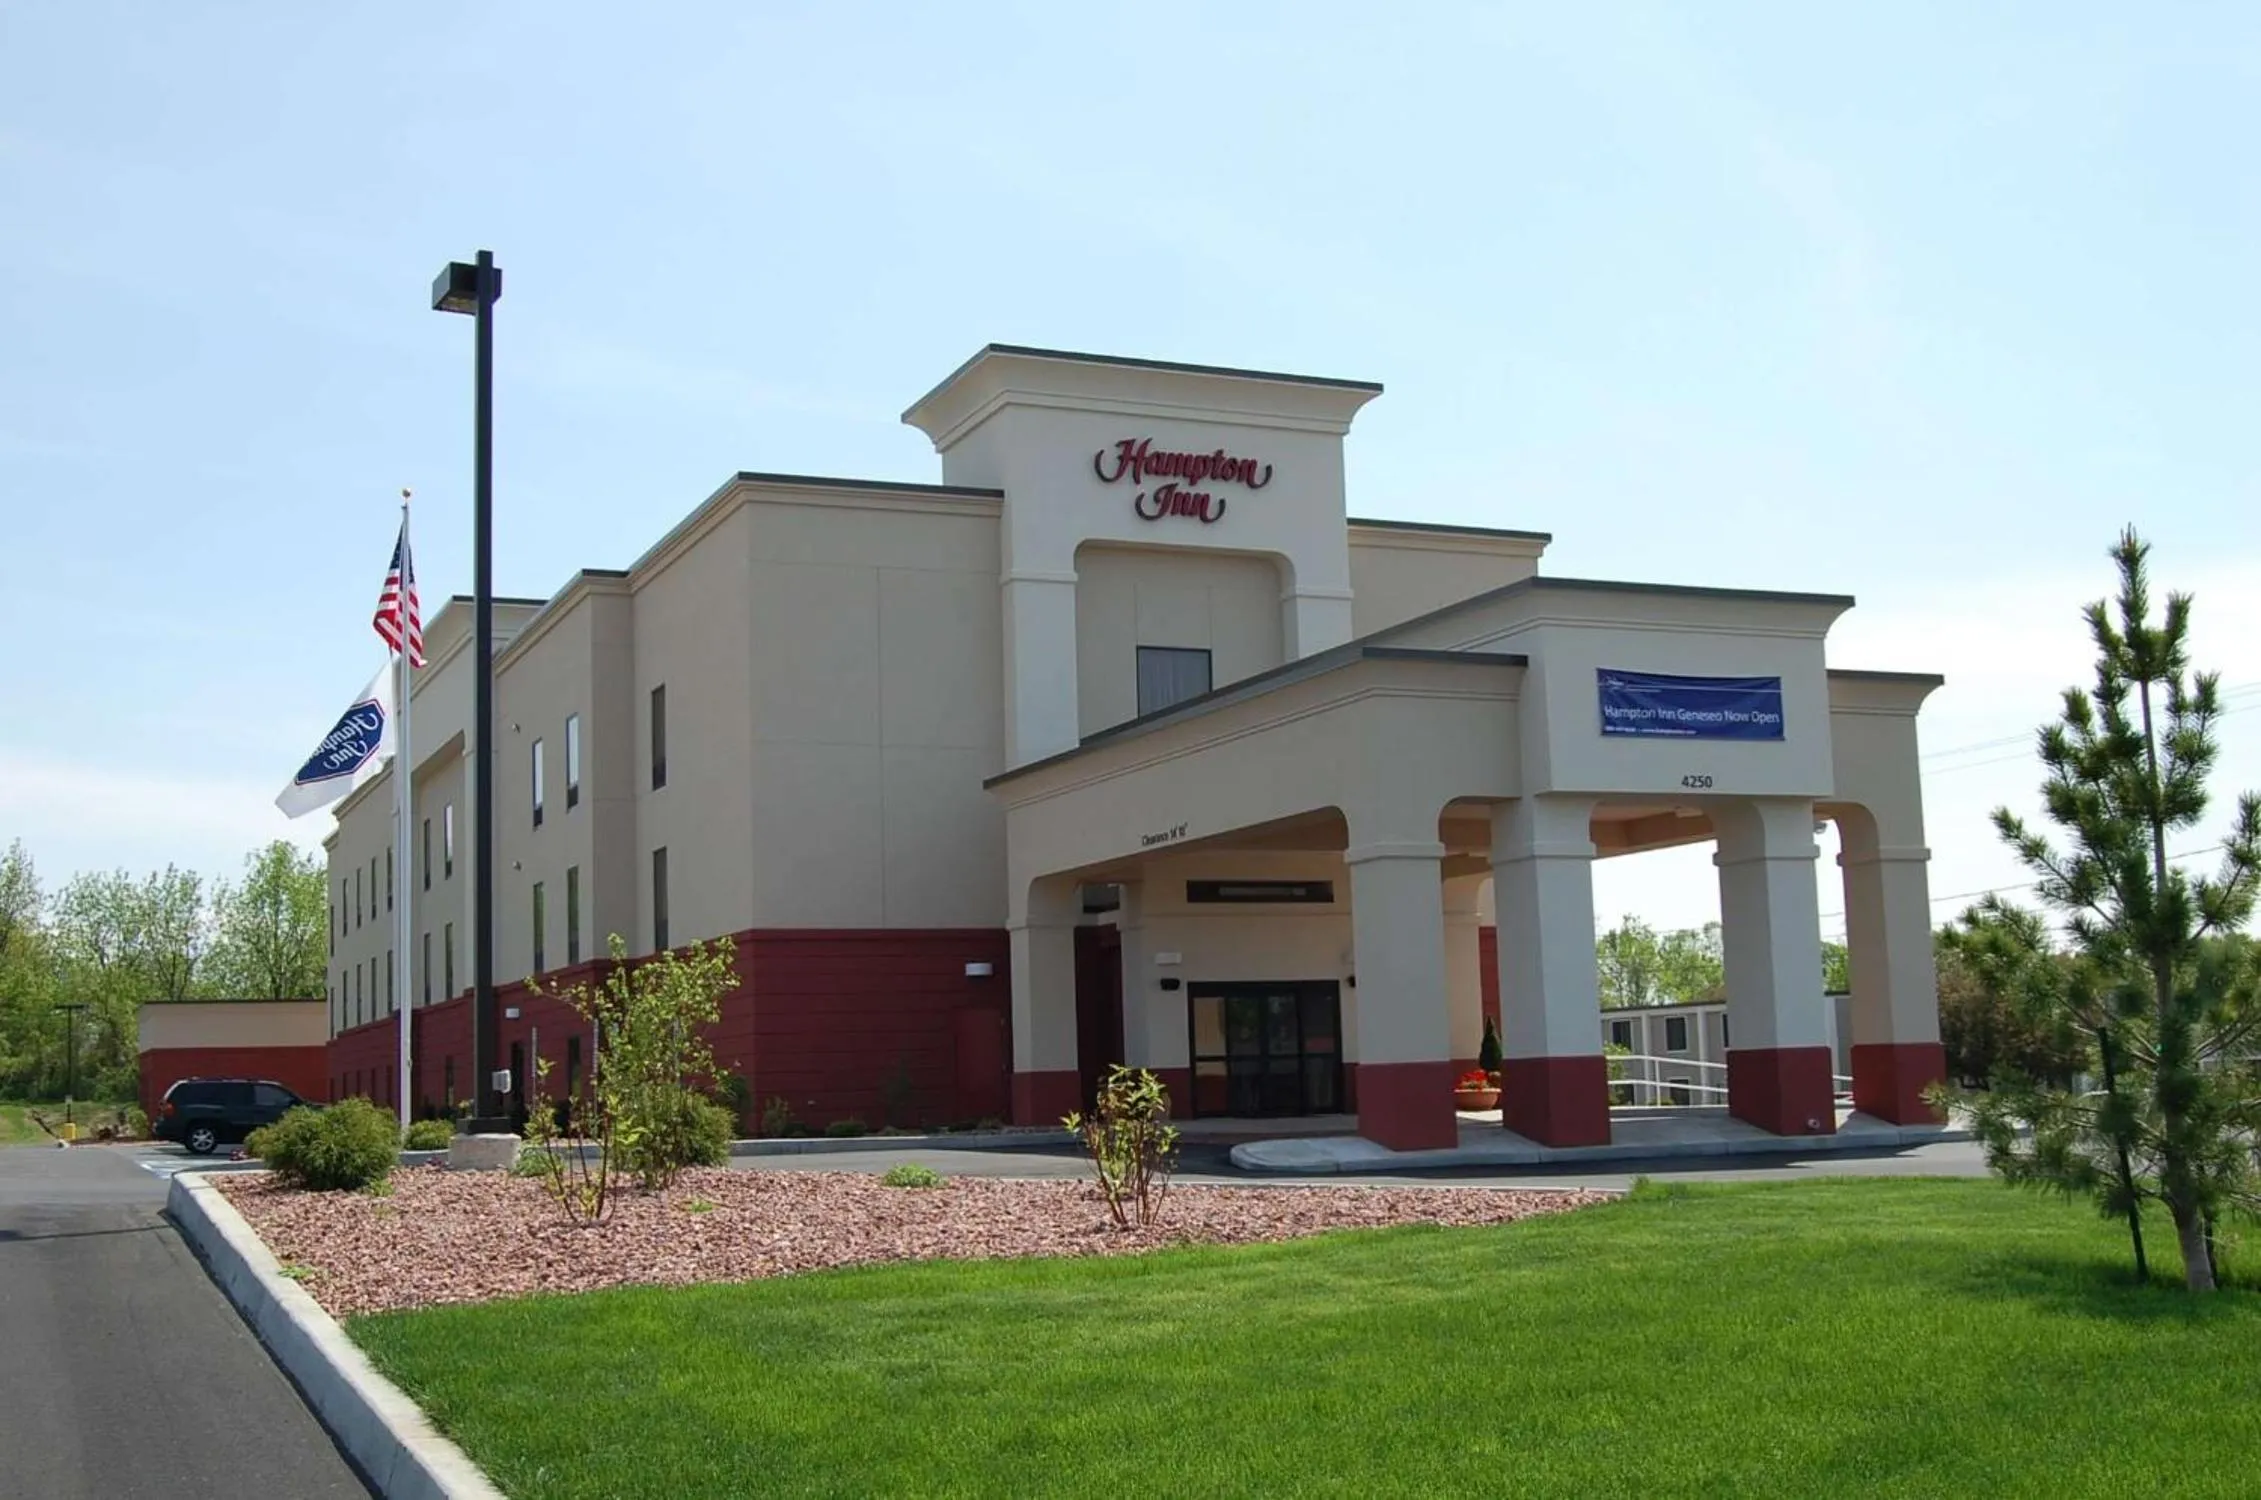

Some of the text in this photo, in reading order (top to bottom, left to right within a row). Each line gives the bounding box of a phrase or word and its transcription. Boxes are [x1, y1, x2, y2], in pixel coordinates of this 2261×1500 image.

[1095, 437, 1272, 489] Hampton
[1135, 483, 1226, 524] Inn
[1604, 705, 1780, 724] Hampton Inn Geneseo Now Open
[1681, 775, 1712, 788] 4250
